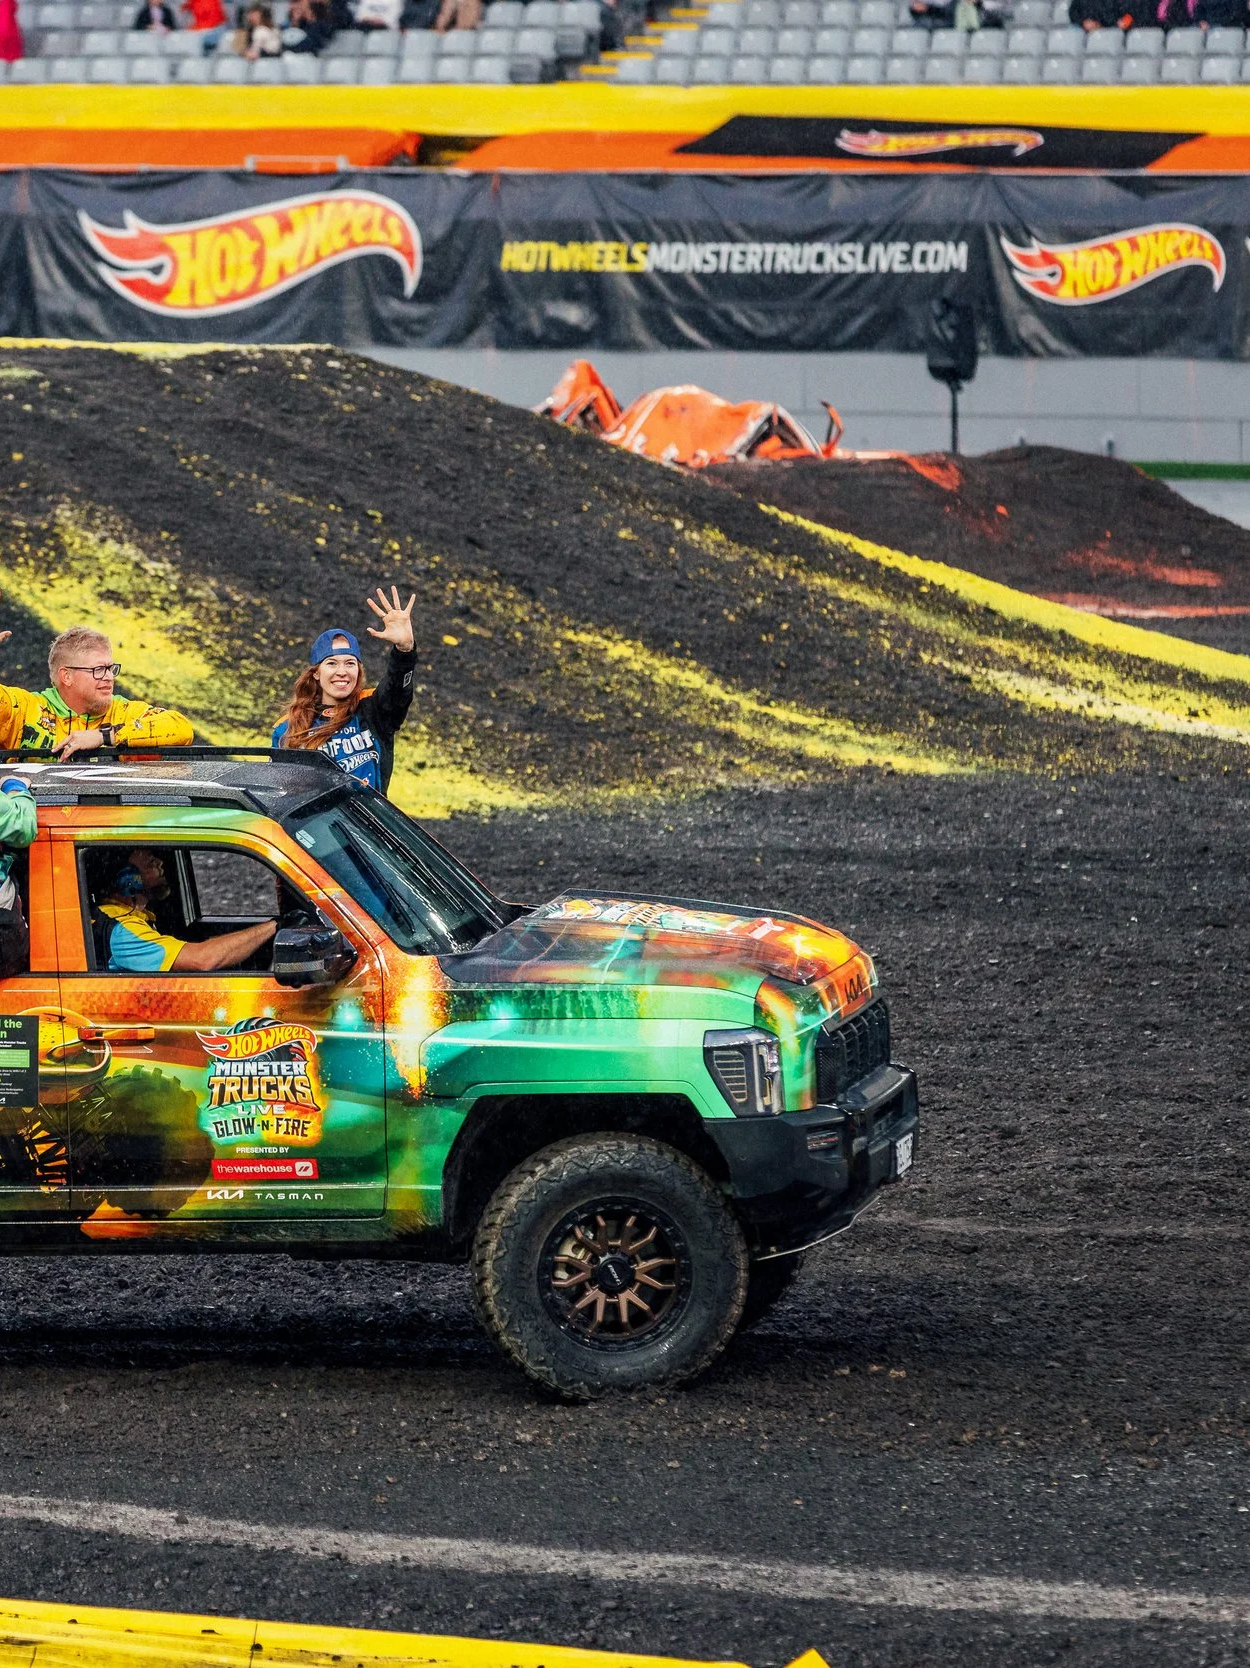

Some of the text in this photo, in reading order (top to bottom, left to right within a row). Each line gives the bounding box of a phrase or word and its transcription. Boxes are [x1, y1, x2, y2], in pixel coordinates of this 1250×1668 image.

[164, 215, 259, 306] HOT
[1057, 244, 1118, 298] HOT
[4, 1018, 23, 1029] the
[226, 1027, 311, 1058] HOT WHEELS
[212, 1060, 309, 1077] MONSTER
[207, 1075, 316, 1110] TRUCKS
[236, 1104, 286, 1116] LIVE
[212, 1117, 256, 1139] GLOW
[274, 1117, 312, 1138] FIRE
[236, 1146, 290, 1154] PRESENTED BY
[217, 1163, 293, 1174] thewarehouse
[206, 1189, 324, 1201] KIA TASMAN
